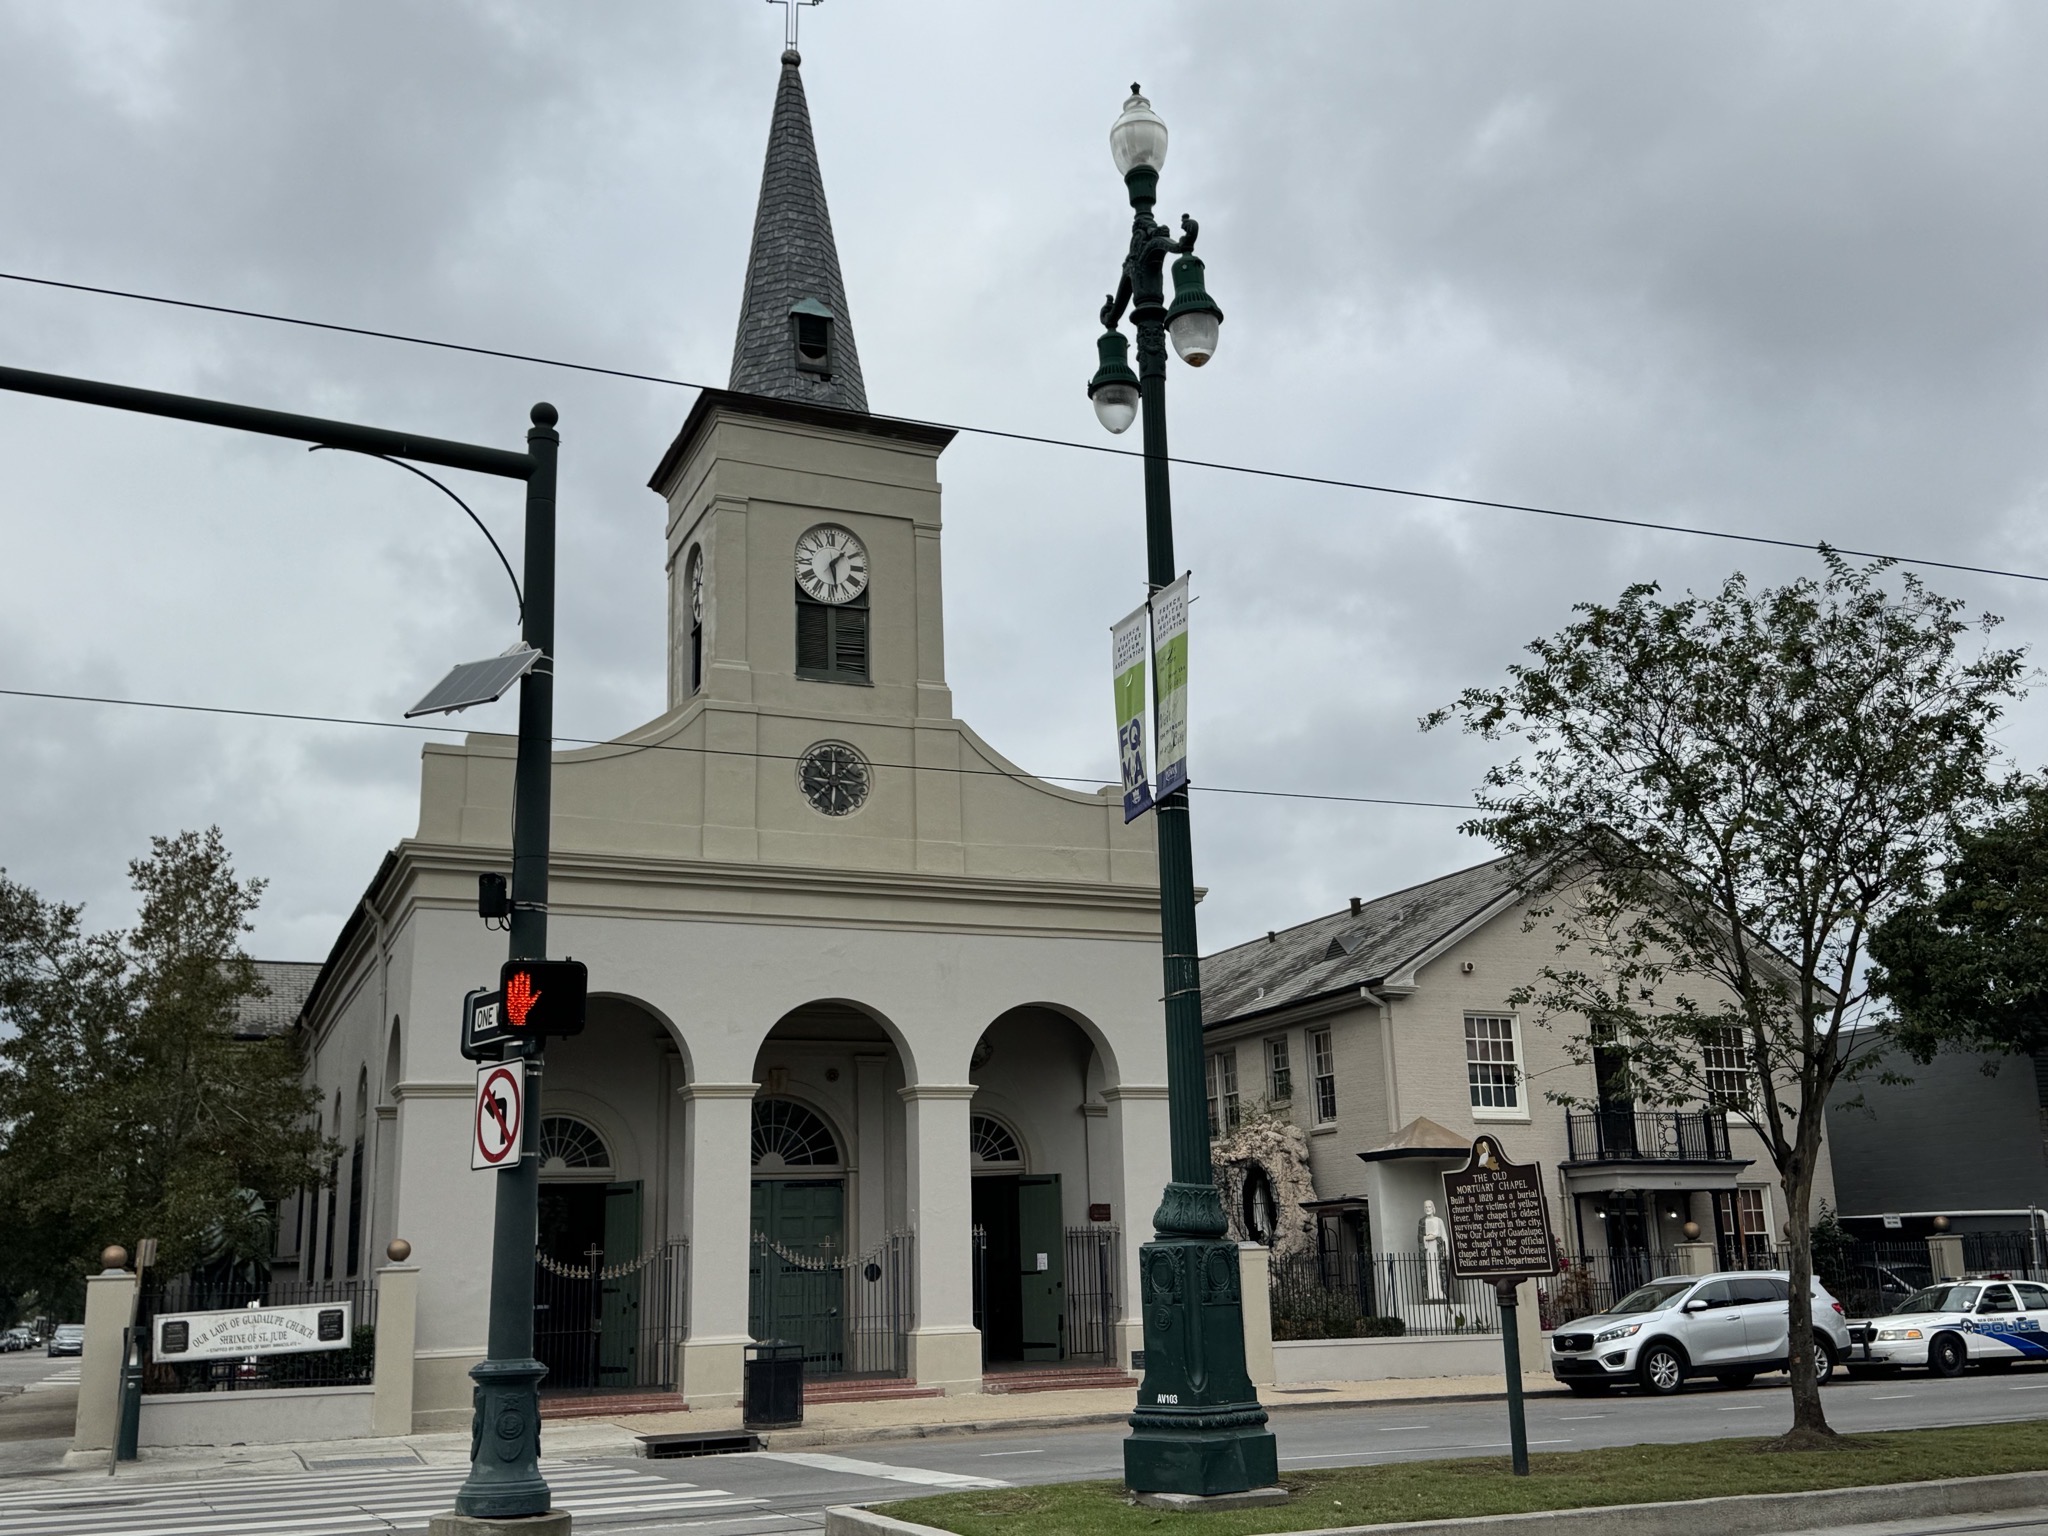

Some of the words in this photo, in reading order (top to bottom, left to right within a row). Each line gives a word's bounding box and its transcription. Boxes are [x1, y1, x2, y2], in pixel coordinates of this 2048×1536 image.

[1160, 596, 1181, 615] FRENCH
[1120, 625, 1140, 644] FRENCH
[1120, 718, 1141, 760] FQ
[1122, 751, 1144, 791] MA
[478, 1006, 494, 1028] ONE
[1472, 1173, 1488, 1183] THE
[1492, 1171, 1507, 1181] OLD
[1456, 1182, 1494, 1194] MORTUARY
[1499, 1179, 1528, 1190] CHAPEL
[1450, 1196, 1465, 1205] Built
[1517, 1190, 1538, 1199] burial
[1452, 1205, 1473, 1213] church
[1474, 1204, 1484, 1212] for
[1485, 1201, 1508, 1210] victims
[1509, 1200, 1516, 1209] of
[1517, 1199, 1538, 1210] yellow
[1487, 1211, 1508, 1221] chapel
[1511, 1210, 1517, 1218] is
[1520, 1209, 1540, 1217] oldest
[1454, 1222, 1482, 1232] surviving
[1483, 1221, 1506, 1229] church
[1507, 1220, 1513, 1228] in
[1515, 1219, 1527, 1227] the
[1456, 1232, 1468, 1240] Now
[1470, 1231, 1482, 1239] Our
[1483, 1230, 1498, 1239] Lady
[1500, 1228, 1506, 1237] of
[1457, 1241, 1467, 1249] the
[1472, 1239, 1492, 1249] chapel
[1496, 1239, 1502, 1247] is
[1506, 1238, 1517, 1246] the
[1521, 1236, 1544, 1245] official
[1458, 1249, 1479, 1258] chapel
[1481, 1248, 1487, 1256] of
[1491, 1248, 1501, 1256] the
[1503, 1247, 1516, 1255] New
[1519, 1246, 1546, 1255] Orleans
[1459, 1258, 1478, 1267] Police
[1479, 1258, 1490, 1266] and
[1492, 1257, 1504, 1265] Fire
[192, 1333, 209, 1348] OUR
[209, 1322, 229, 1337] LADY
[230, 1317, 239, 1328] OF
[242, 1314, 284, 1326] GUADALUPE
[286, 1320, 314, 1339] CHURCH
[1980, 1319, 2041, 1334] POLICE
[219, 1334, 246, 1345] SHRINE
[248, 1333, 256, 1342] OF
[258, 1332, 268, 1342] ST.
[270, 1331, 287, 1343] JUDE
[1157, 1394, 1178, 1404] AV103
